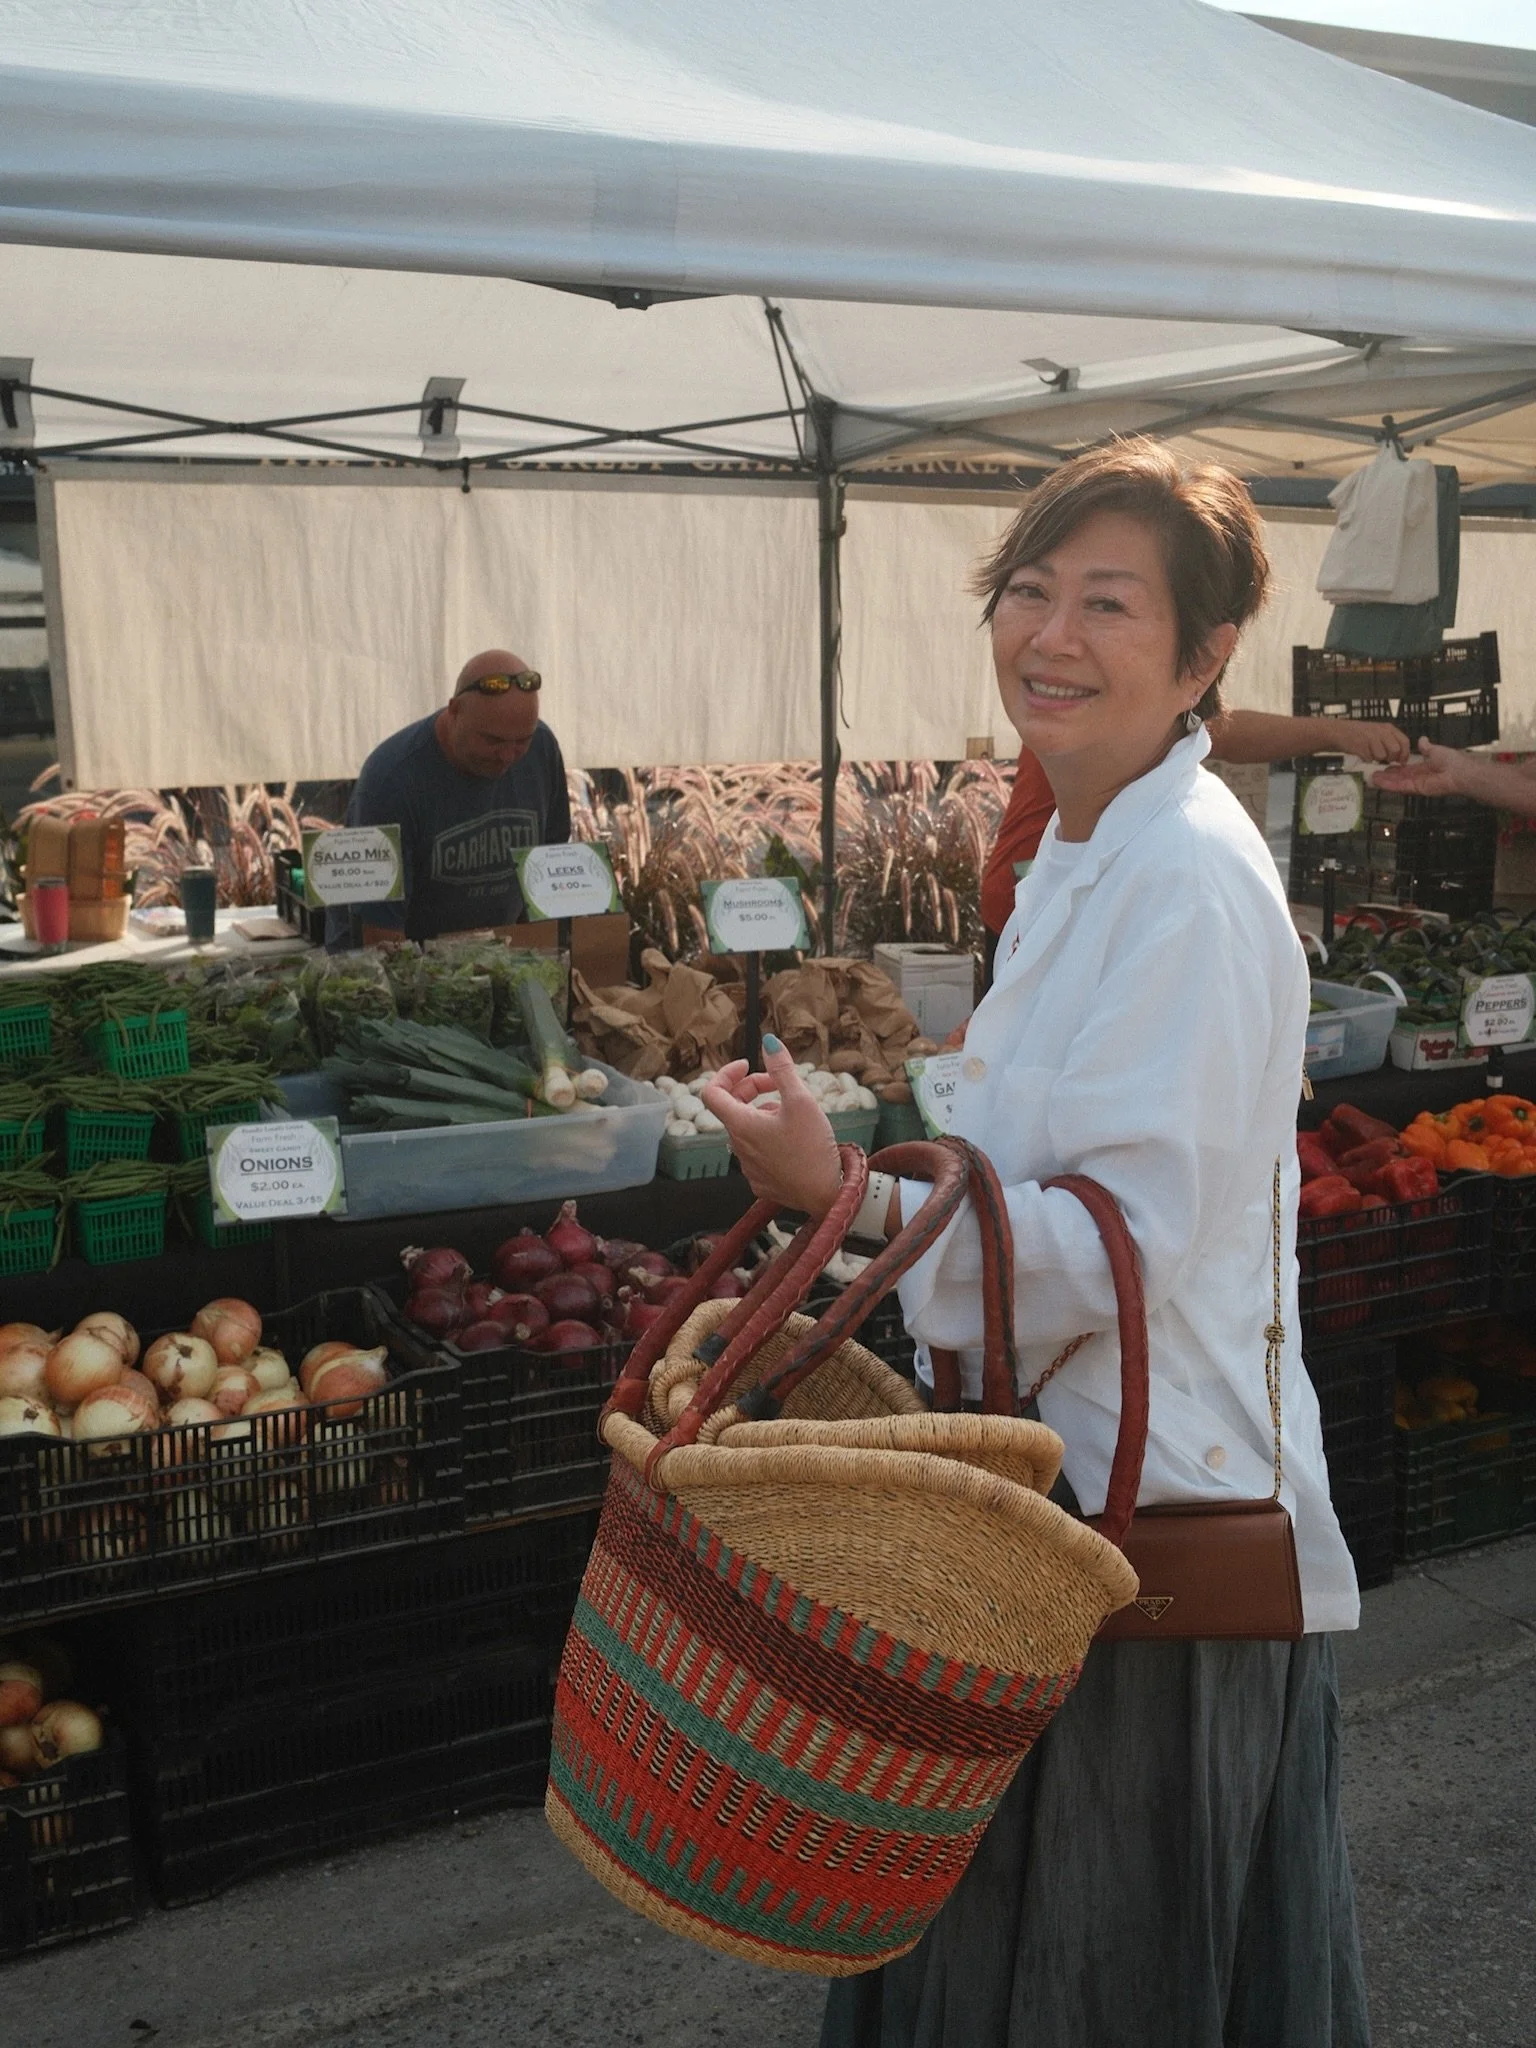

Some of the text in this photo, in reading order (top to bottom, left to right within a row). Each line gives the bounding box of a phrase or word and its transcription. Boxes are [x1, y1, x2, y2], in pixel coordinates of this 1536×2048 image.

[443, 825, 534, 871] CARHARTT
[314, 847, 391, 863] SALAD MIX
[331, 867, 361, 877] $6.00
[547, 865, 585, 876] LEEKS
[723, 899, 783, 909] MUSHROOMS
[1475, 998, 1527, 1011] PEPPERS
[240, 1156, 313, 1172] ONIONS
[251, 1180, 289, 1192] $2.00
[236, 1195, 324, 1209] VALUE DEAL 3/$5
